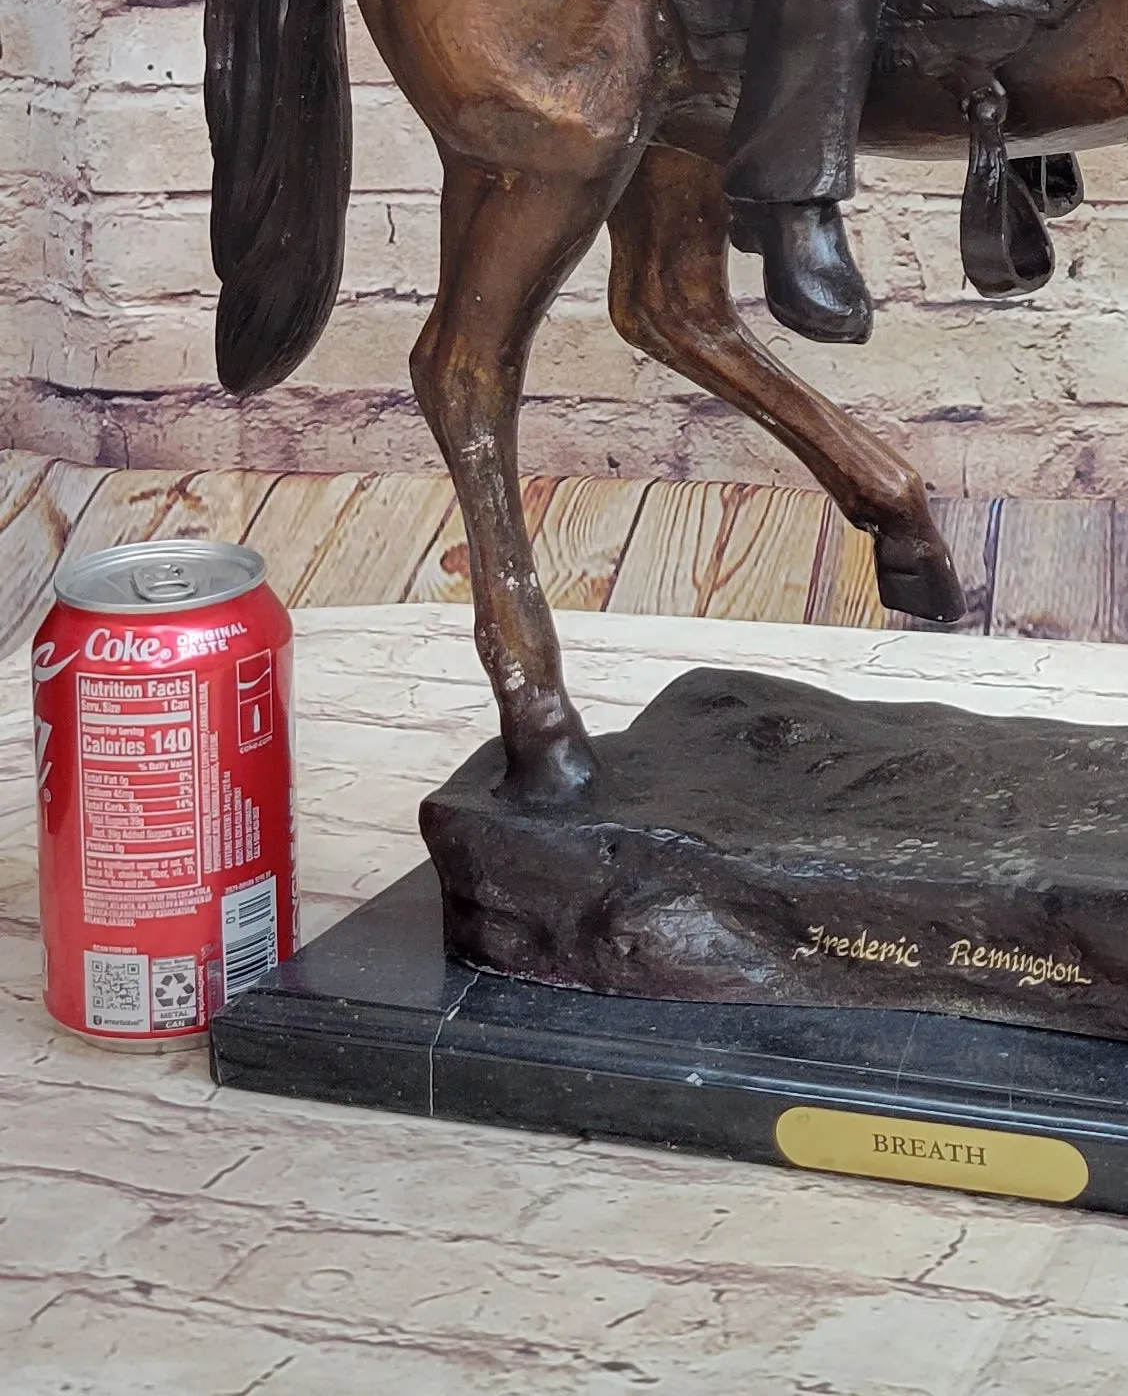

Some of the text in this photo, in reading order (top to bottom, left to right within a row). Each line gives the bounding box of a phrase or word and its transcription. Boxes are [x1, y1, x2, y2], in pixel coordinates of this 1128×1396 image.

[84, 627, 162, 662] Coke
[176, 622, 247, 647] ORIGINAL
[177, 639, 229, 659] TASTE
[81, 678, 191, 698] Nutrition Facts
[102, 701, 121, 714] Size
[162, 699, 190, 712] 1 Can
[82, 727, 192, 756] Calories 140
[792, 924, 1092, 988] Frederic Remington
[160, 1010, 189, 1020] METAL
[165, 1019, 186, 1029] CAN
[872, 1133, 987, 1167] BREATH
